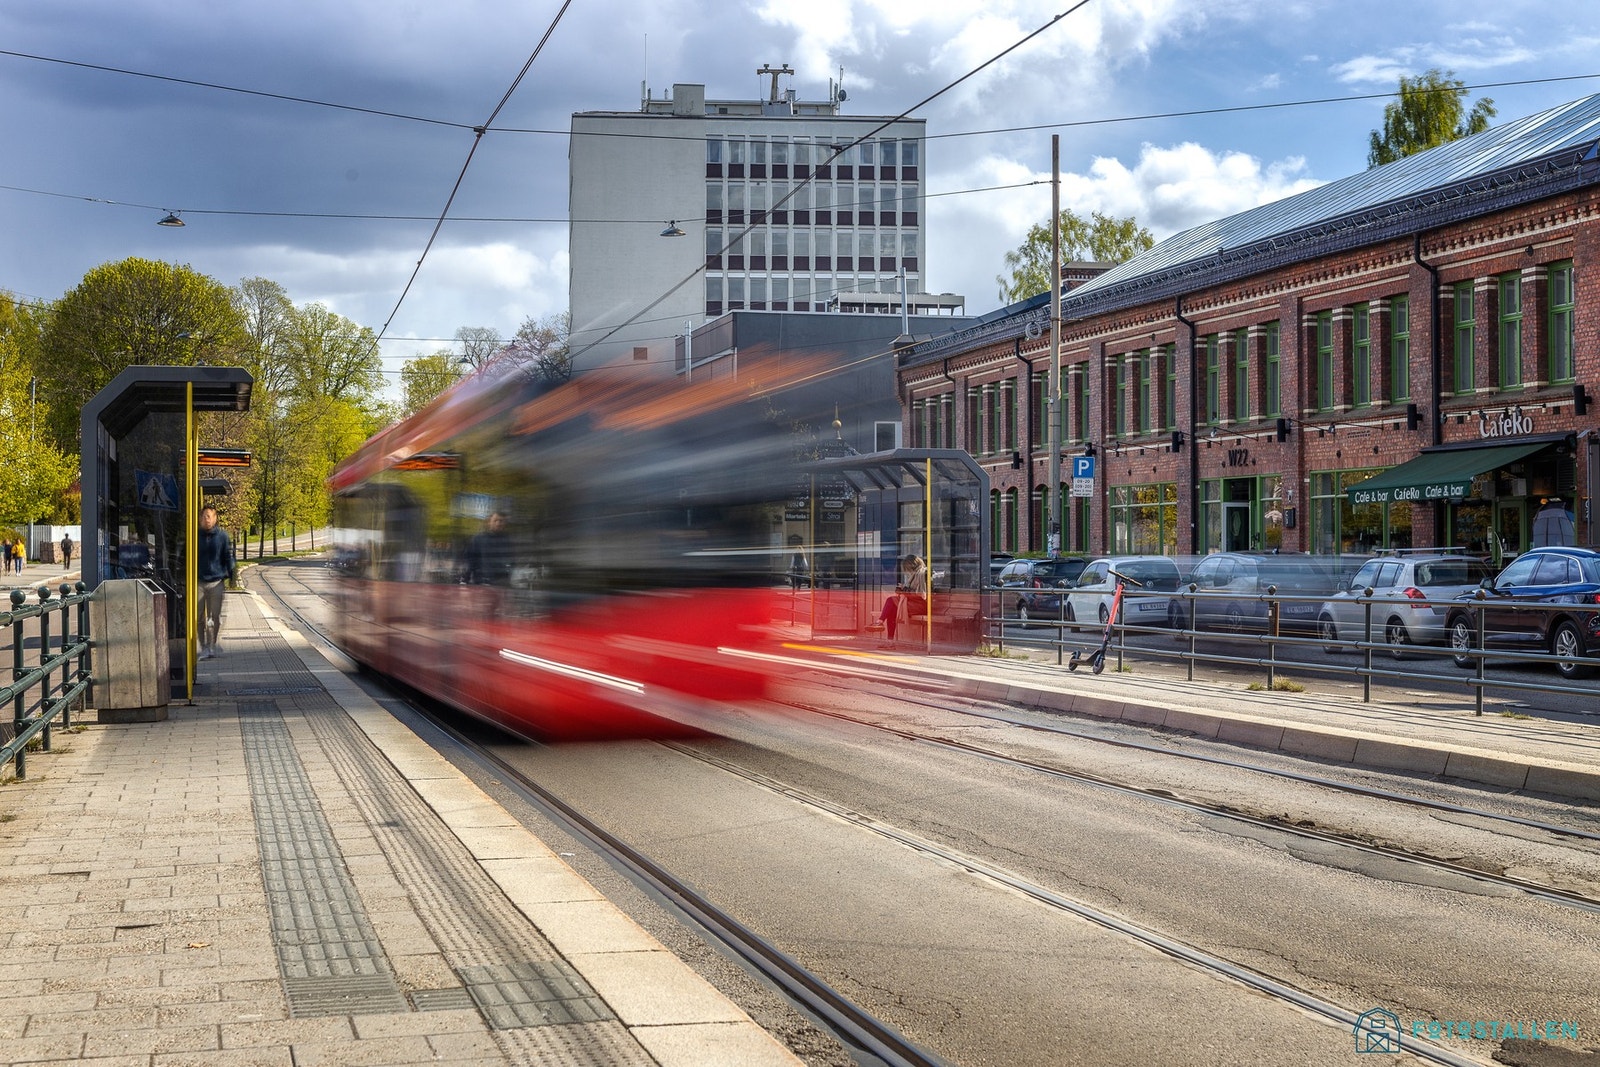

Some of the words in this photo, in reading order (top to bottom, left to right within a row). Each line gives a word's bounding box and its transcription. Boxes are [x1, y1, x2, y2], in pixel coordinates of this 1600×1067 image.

[1228, 449, 1249, 467] W22
[1078, 459, 1090, 476] P
[1355, 491, 1370, 503] Cafe
[1371, 491, 1376, 501] &
[1377, 490, 1389, 501] bar
[1394, 487, 1420, 500] CafeRo
[1425, 485, 1442, 498] Cafe
[1443, 485, 1449, 496] &
[1450, 484, 1464, 496] bar
